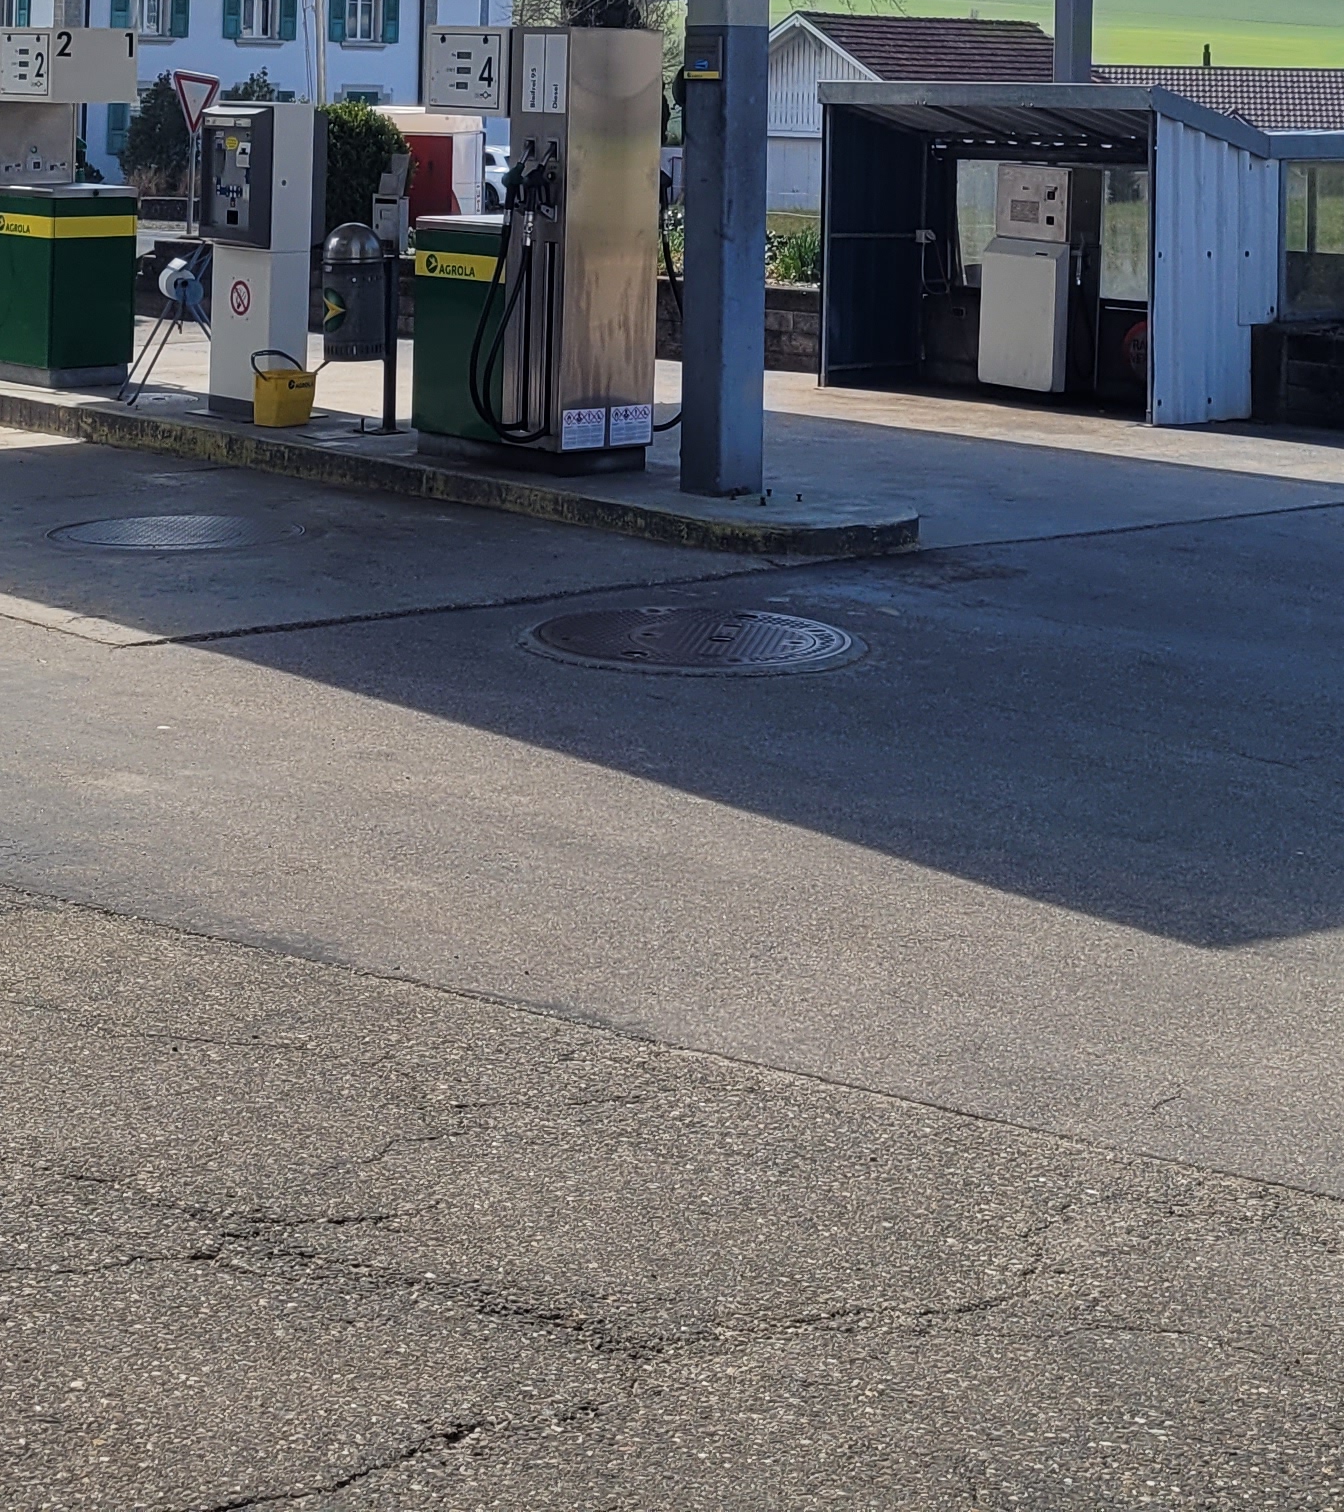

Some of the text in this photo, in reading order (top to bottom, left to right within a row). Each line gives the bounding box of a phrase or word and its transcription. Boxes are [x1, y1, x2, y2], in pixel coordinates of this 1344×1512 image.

[56, 31, 134, 58] 2 1
[34, 52, 44, 78] 2
[478, 56, 494, 88] 4
[6, 222, 31, 234] AGROLA
[439, 264, 476, 278] AGROLA
